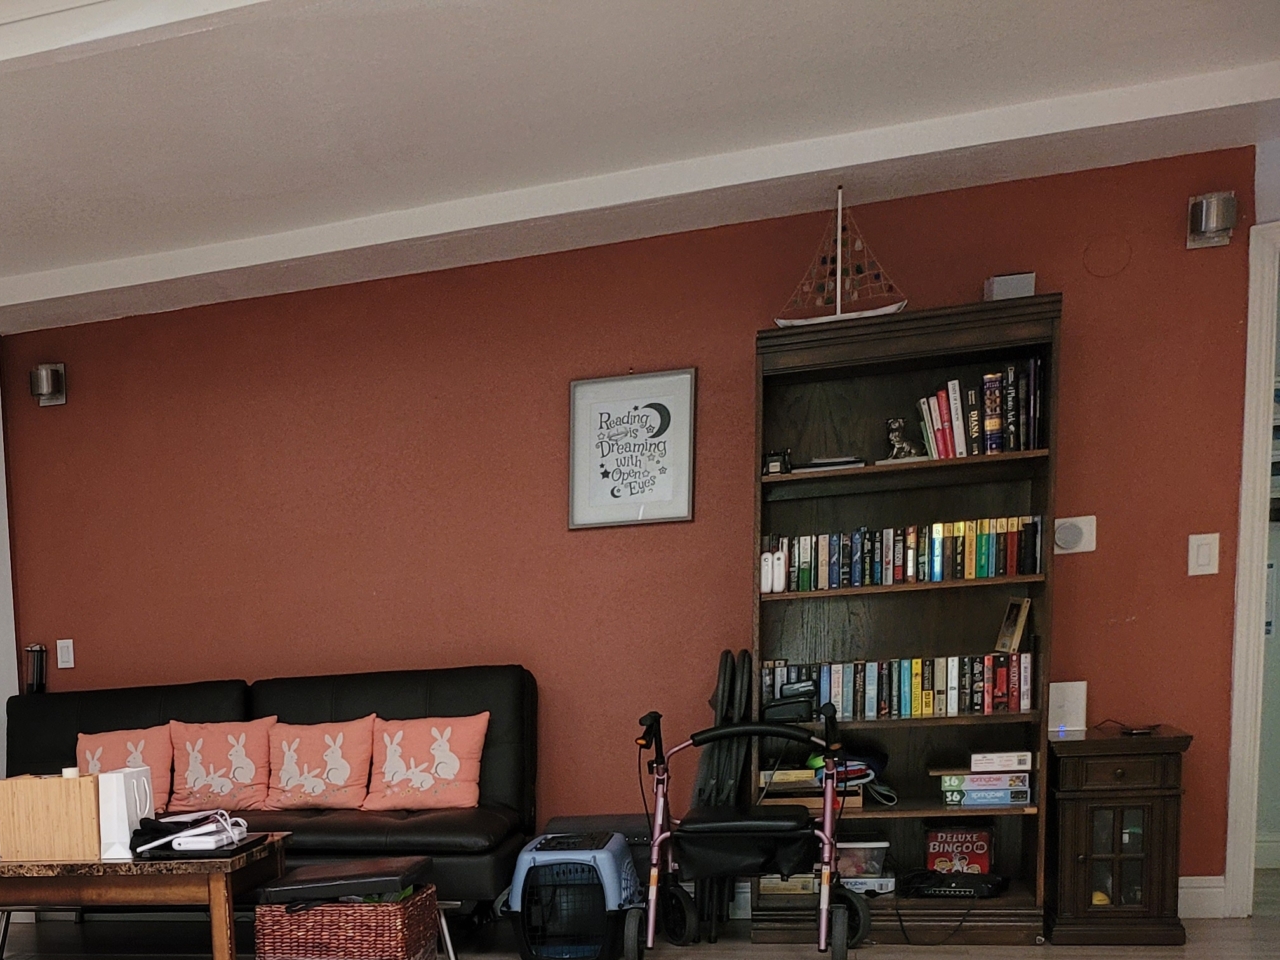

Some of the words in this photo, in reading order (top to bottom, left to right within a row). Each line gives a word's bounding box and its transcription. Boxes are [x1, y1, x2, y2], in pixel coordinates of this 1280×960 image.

[598, 411, 650, 430] Reading
[970, 410, 979, 438] DIANA
[629, 428, 638, 438] is
[596, 439, 667, 458] Dreaming
[616, 456, 642, 468] with
[612, 468, 642, 484] Open
[625, 476, 656, 496] Eyes
[944, 777, 959, 786] 36
[946, 792, 960, 801] 36
[937, 833, 978, 841] DELUXE
[929, 842, 972, 852] BINGO
